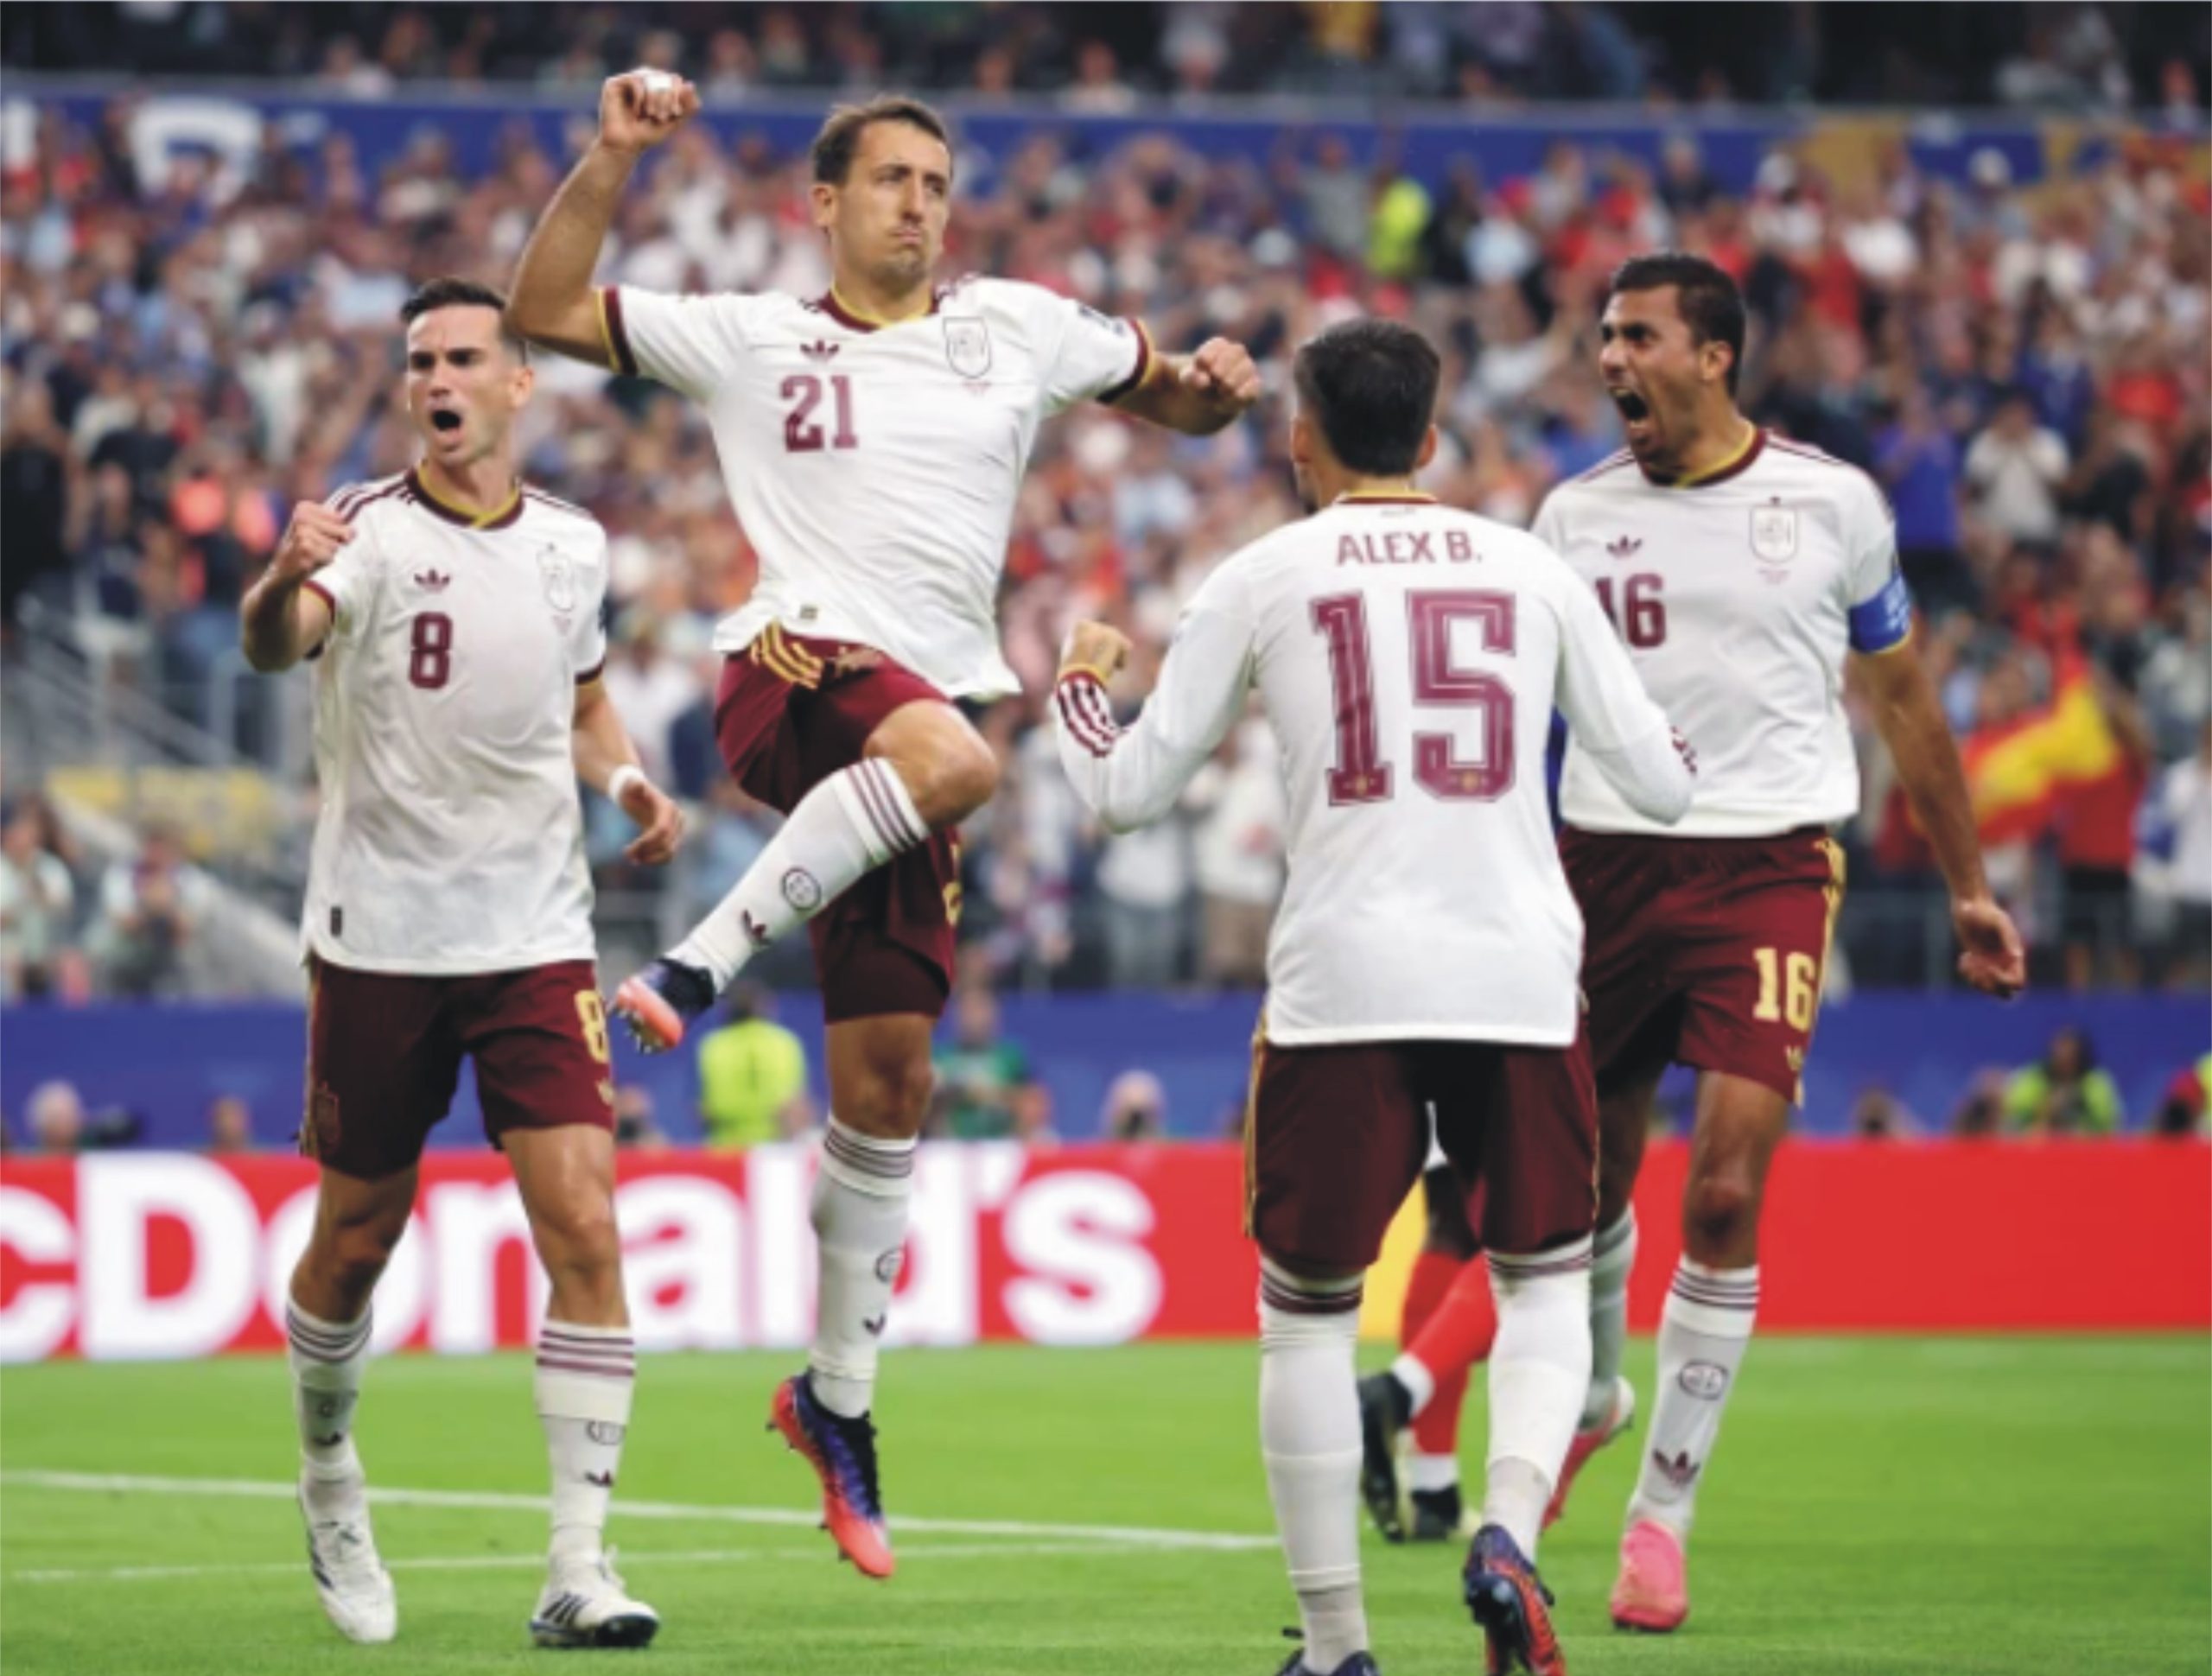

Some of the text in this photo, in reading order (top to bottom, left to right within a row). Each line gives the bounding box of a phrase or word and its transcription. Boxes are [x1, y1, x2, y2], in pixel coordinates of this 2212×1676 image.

[781, 374, 858, 453] 21
[1337, 530, 1483, 566] ALEX B.
[409, 612, 453, 690] 8
[1309, 588, 1516, 807] 15
[574, 988, 609, 1064] 8
[1752, 948, 1815, 1032] 16
